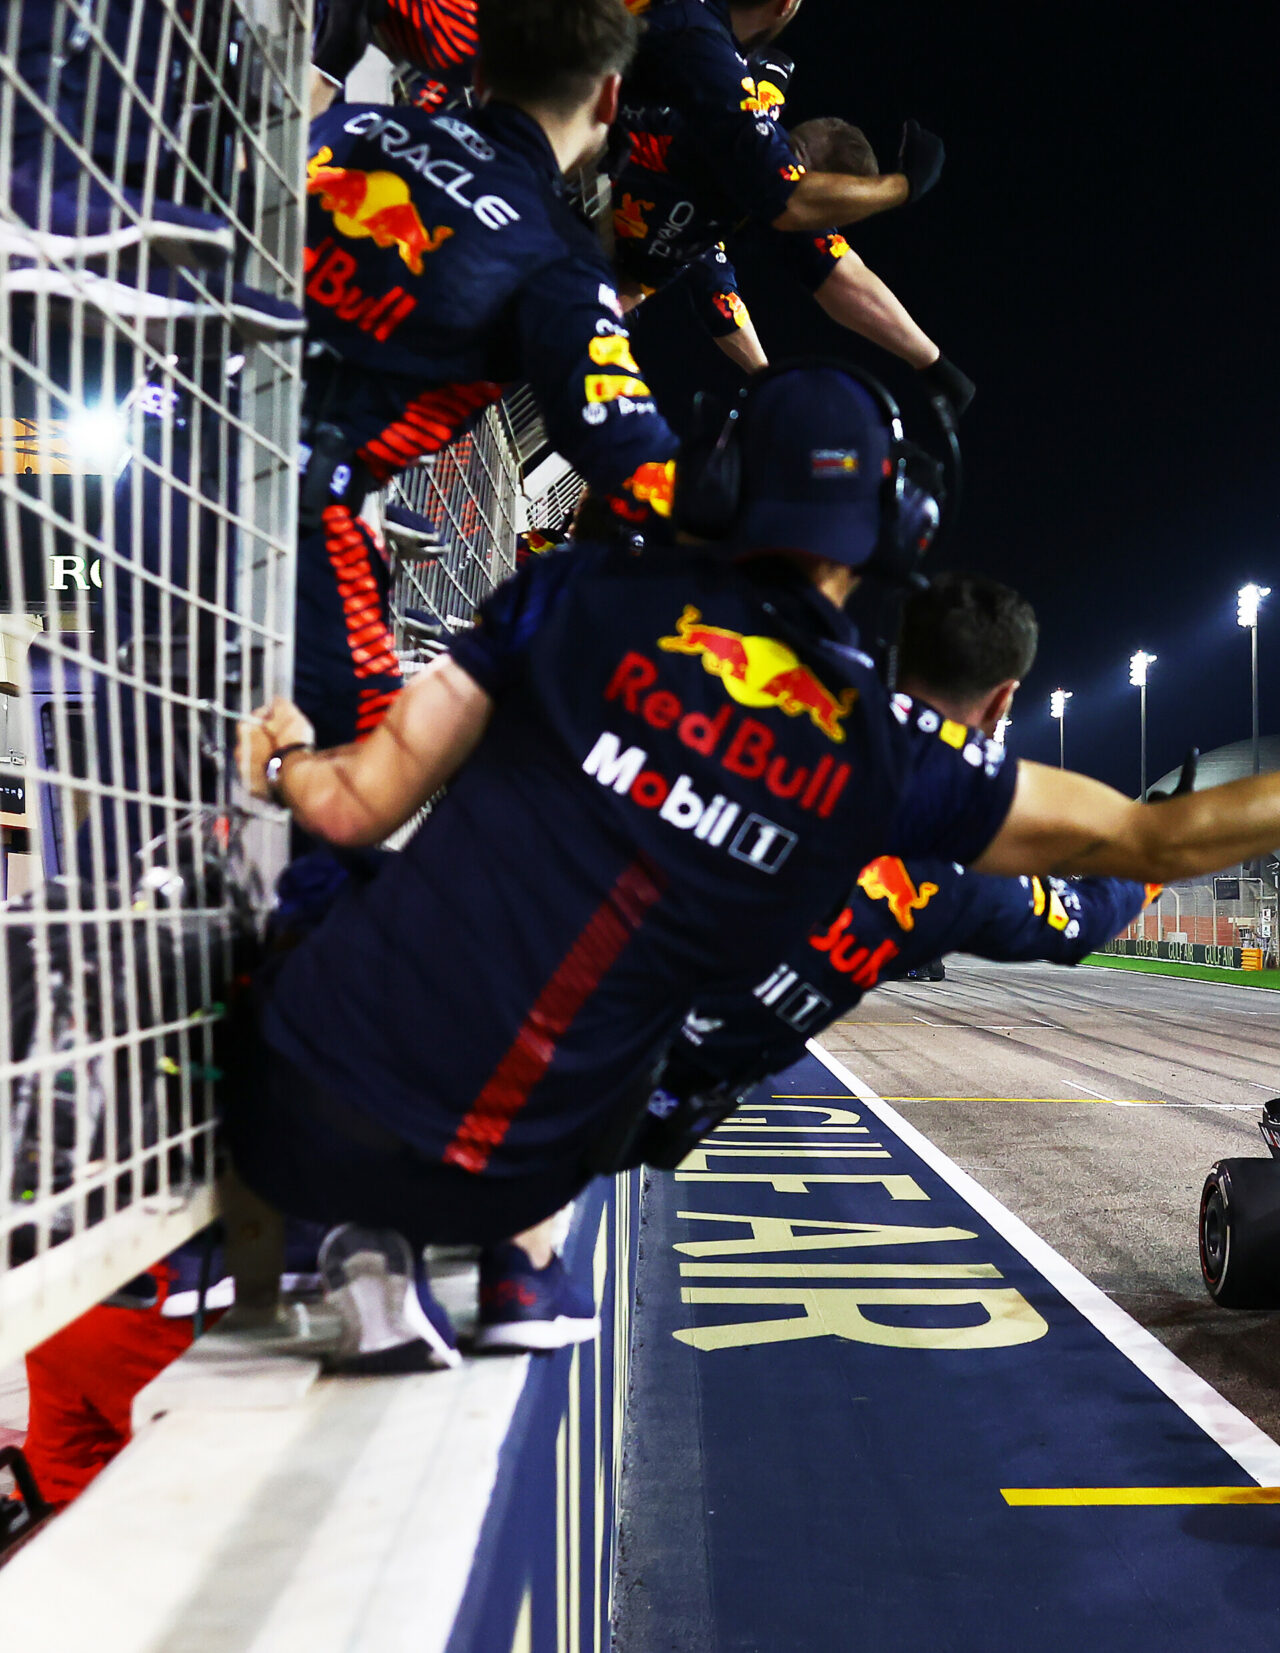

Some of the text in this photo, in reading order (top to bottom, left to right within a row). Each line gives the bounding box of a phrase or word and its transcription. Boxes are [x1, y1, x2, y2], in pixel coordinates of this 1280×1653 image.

[343, 111, 522, 232] ORACLE
[581, 731, 741, 848] Mobil
[1205, 945, 1234, 968] GULF AIR
[672, 1211, 1049, 1352] AIR
